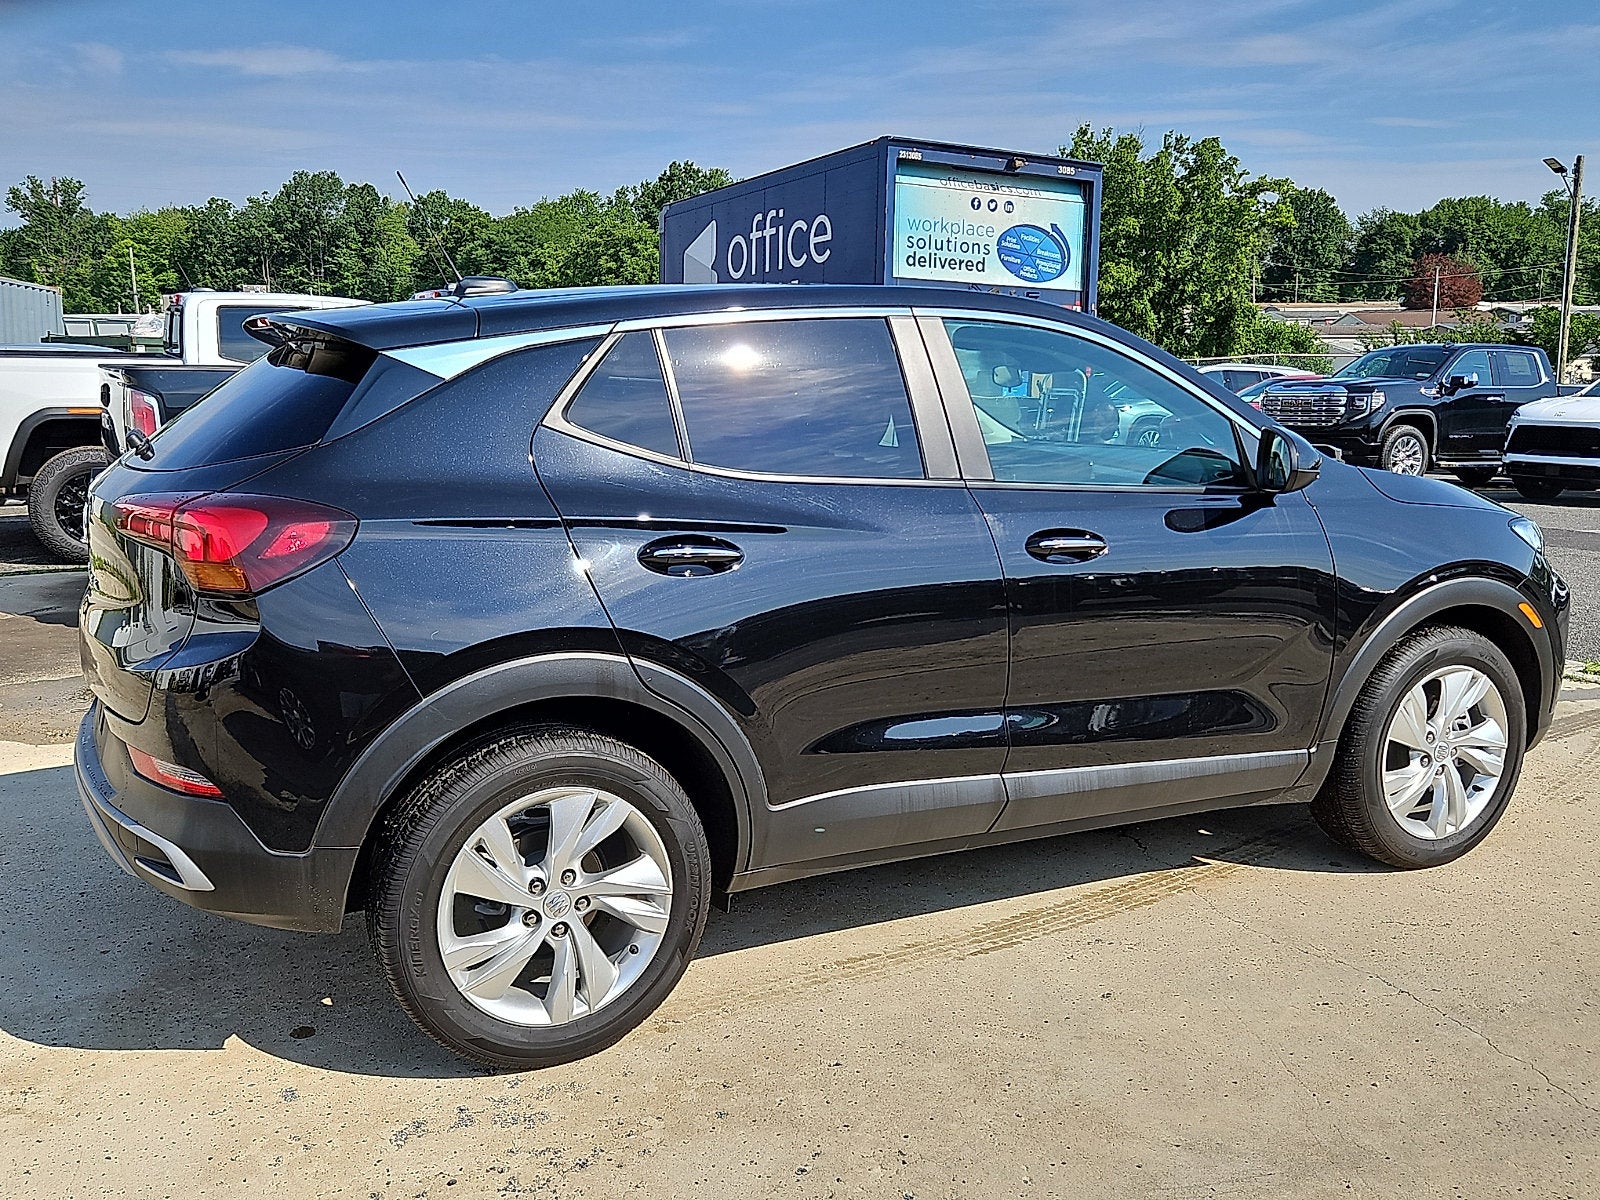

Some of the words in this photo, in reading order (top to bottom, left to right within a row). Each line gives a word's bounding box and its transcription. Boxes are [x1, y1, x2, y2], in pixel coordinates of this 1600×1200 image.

[1057, 165, 1076, 176] 3085
[939, 176, 1042, 198] officebasics.com
[907, 217, 995, 238] workplace
[727, 208, 833, 280] office
[906, 234, 991, 256] solutions
[905, 251, 986, 273] delivered
